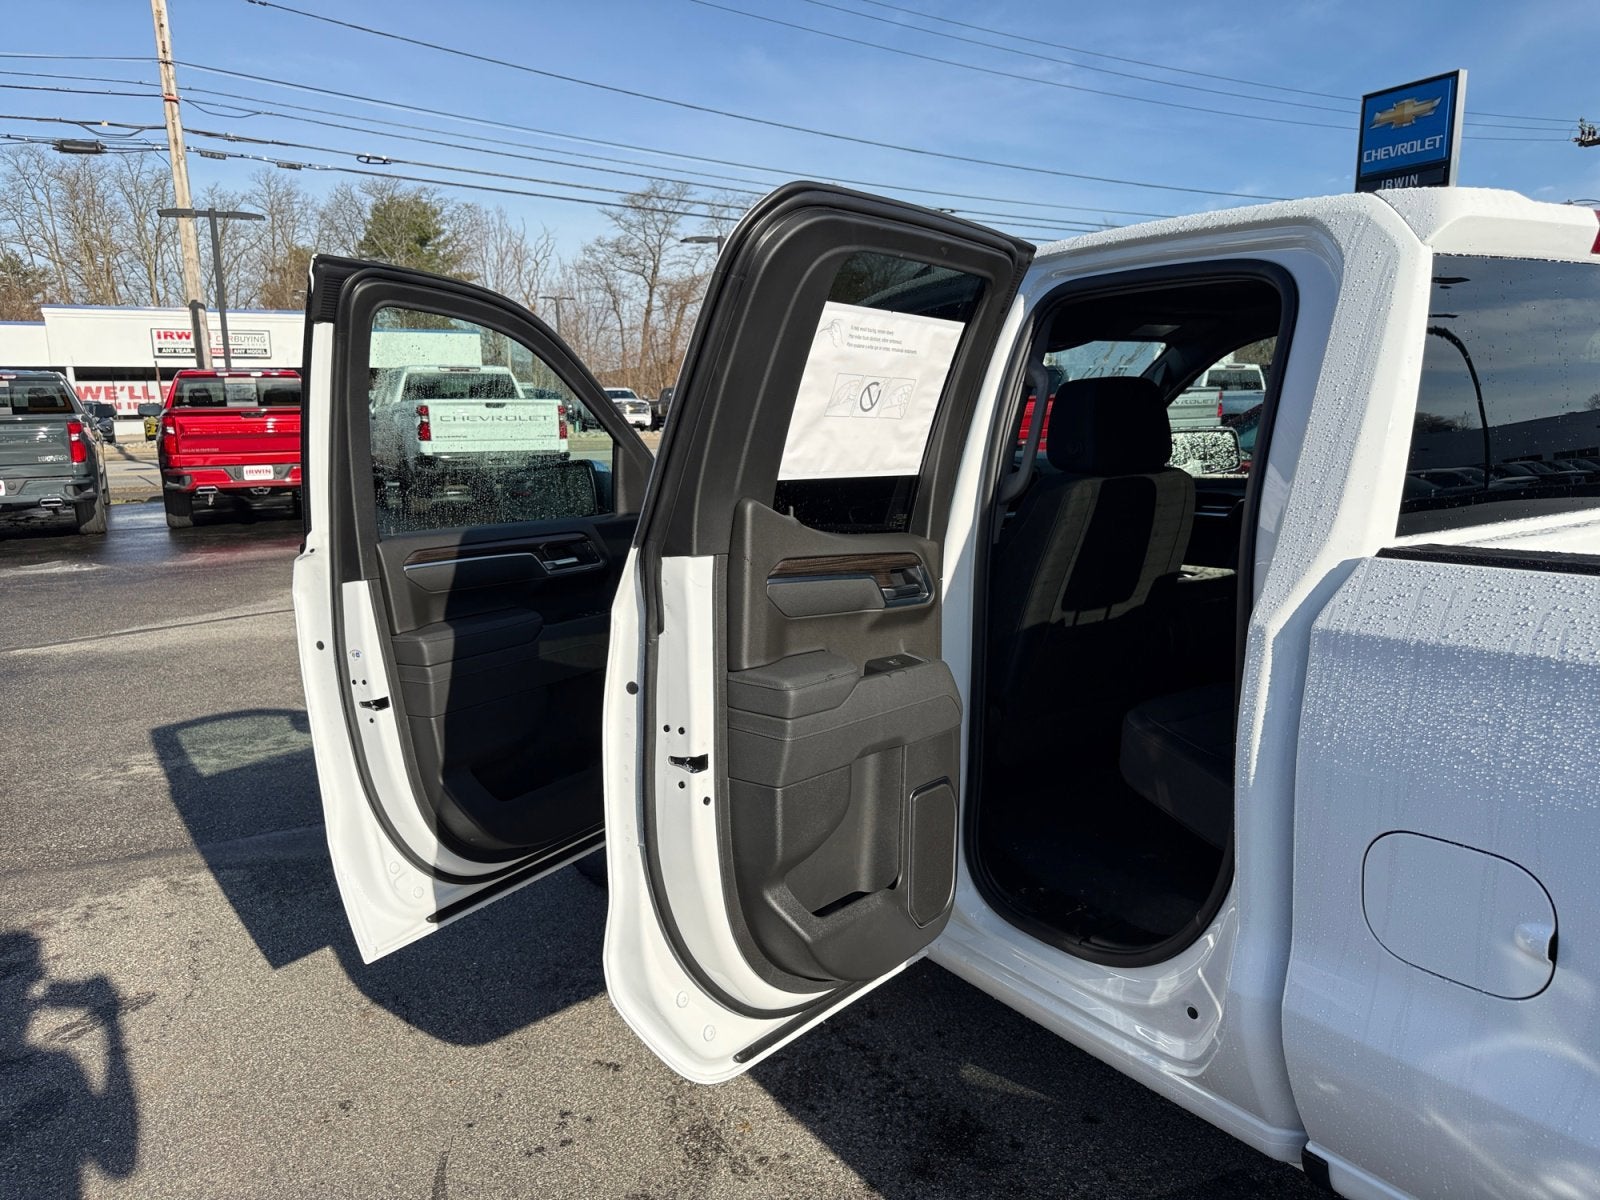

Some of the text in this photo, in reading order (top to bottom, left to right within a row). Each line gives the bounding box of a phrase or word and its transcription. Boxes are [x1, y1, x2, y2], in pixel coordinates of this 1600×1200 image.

[1363, 135, 1444, 163] CHEVROLET
[1381, 174, 1419, 190] IRWIN
[156, 331, 192, 341] IRW
